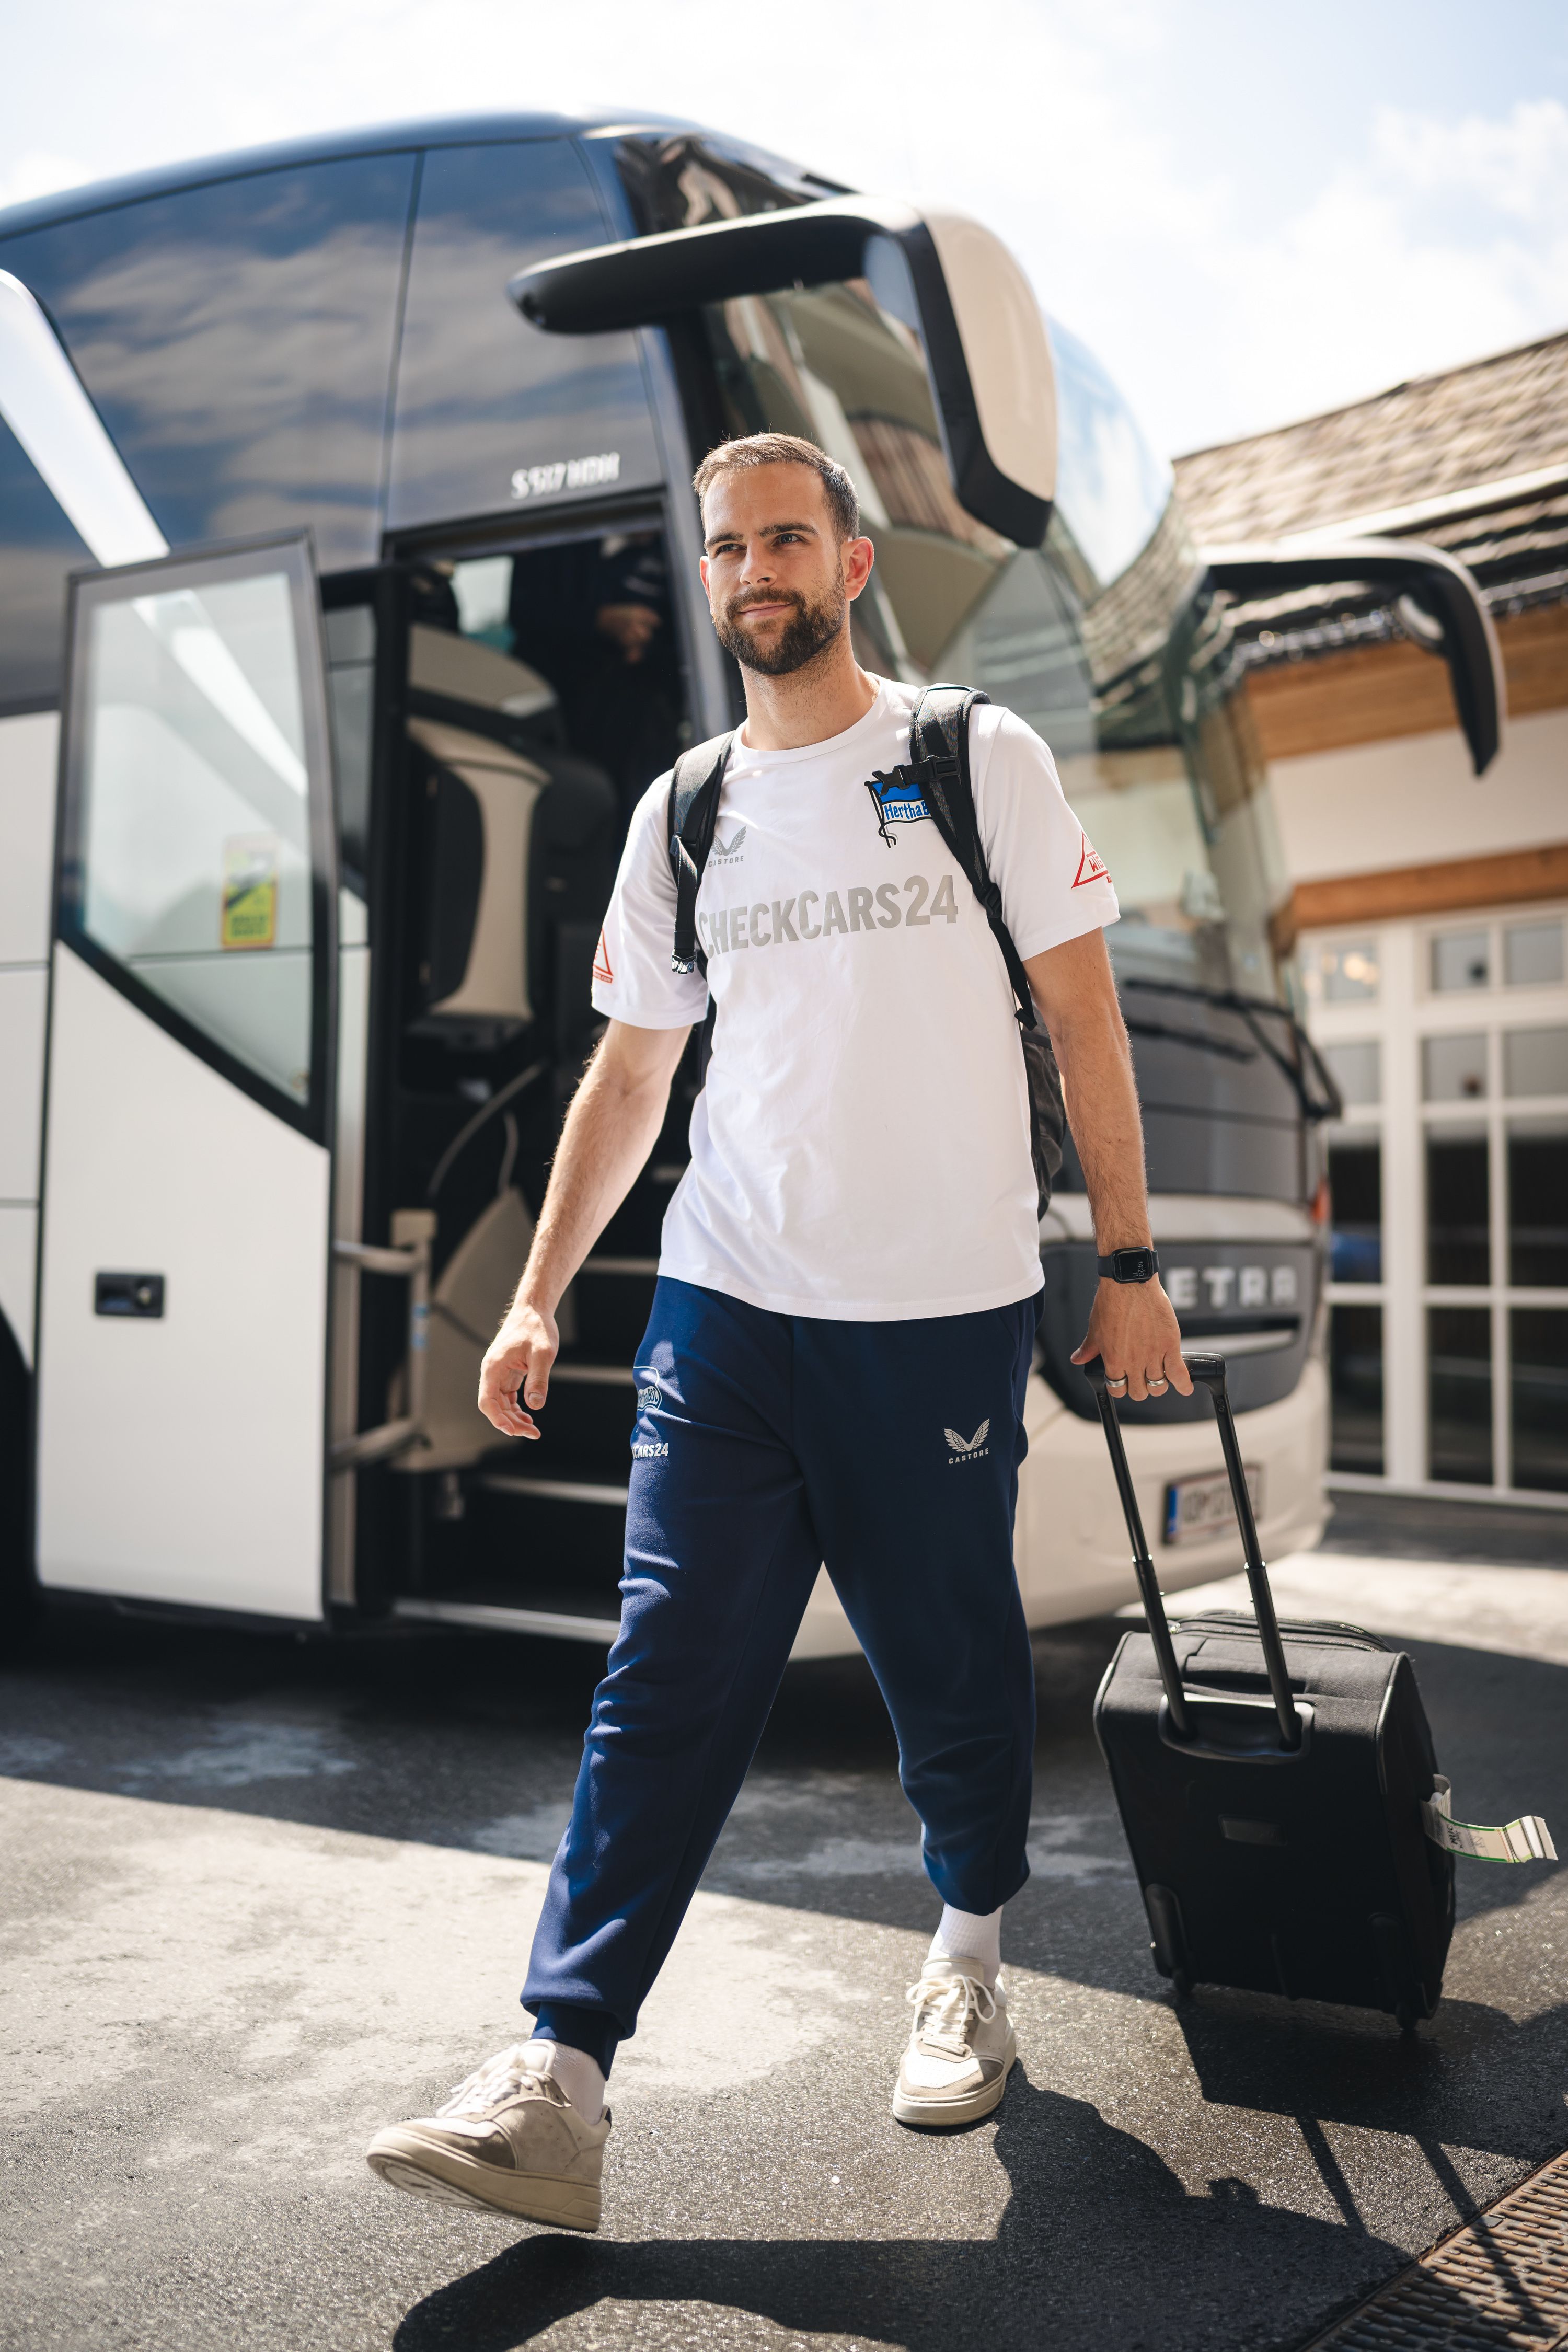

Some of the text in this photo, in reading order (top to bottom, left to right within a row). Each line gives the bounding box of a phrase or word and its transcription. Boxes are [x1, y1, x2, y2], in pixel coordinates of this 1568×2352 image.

[708, 856, 744, 867] CASTORE
[698, 875, 959, 959] CHECKCARS24
[1165, 1264, 1298, 1311] ETRA
[948, 1448, 989, 1464] CASTORE
